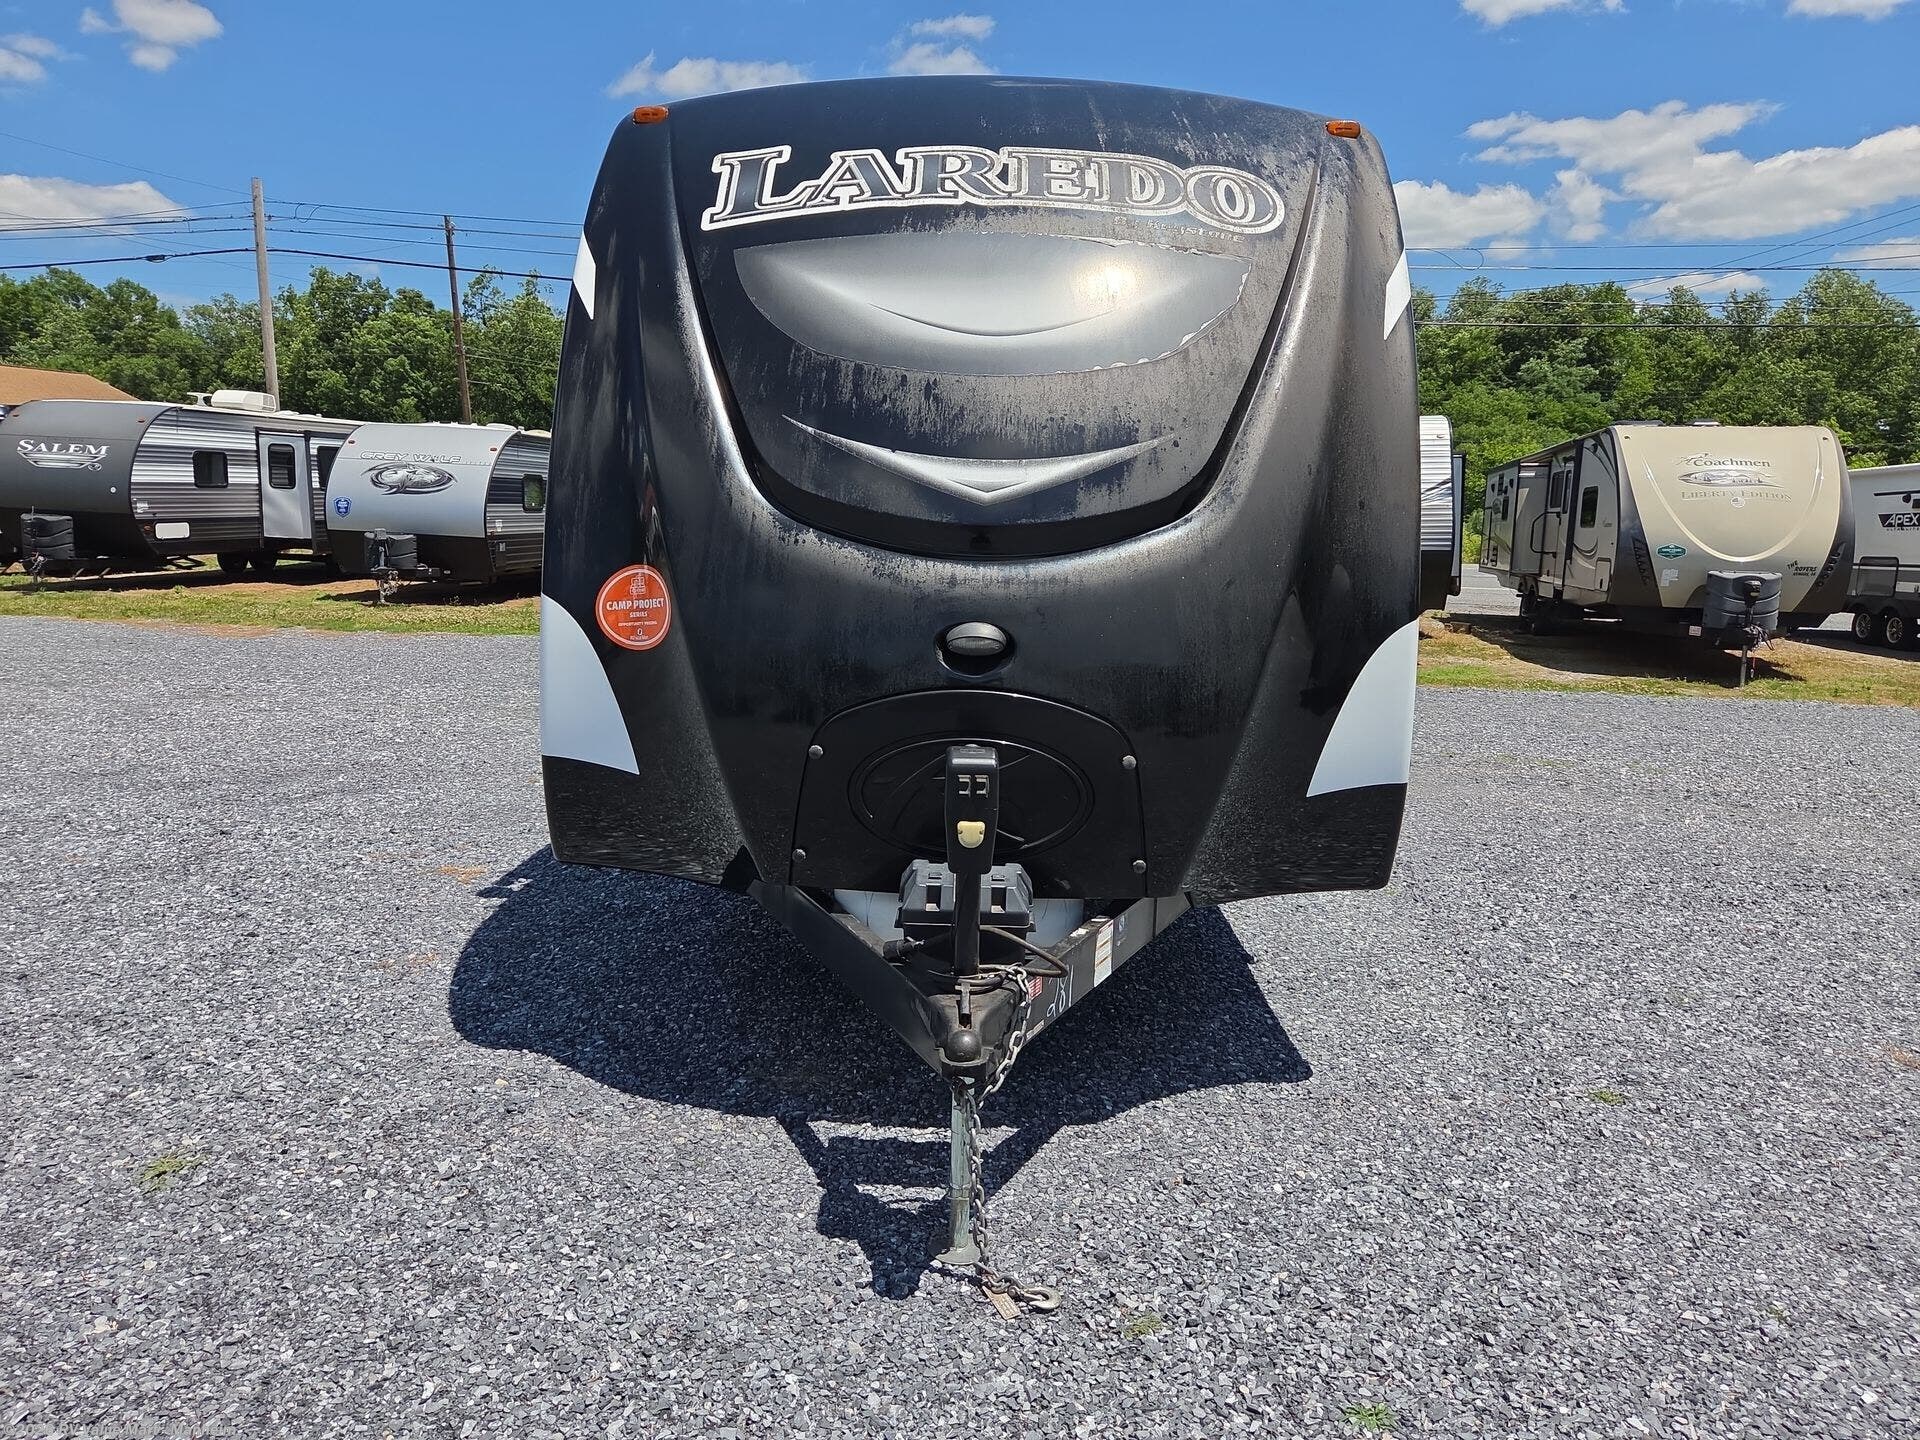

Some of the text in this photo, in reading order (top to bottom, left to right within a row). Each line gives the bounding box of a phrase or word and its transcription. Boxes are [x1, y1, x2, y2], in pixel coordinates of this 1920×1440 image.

[700, 144, 1286, 235] LAREDO
[17, 439, 110, 455] SALEM
[360, 451, 409, 462] GREY
[1693, 458, 1772, 468] Coachmen
[1681, 490, 1737, 500] LIBERTY
[1884, 513, 1920, 527] APEX
[606, 598, 665, 611] CAMP PROJECT
